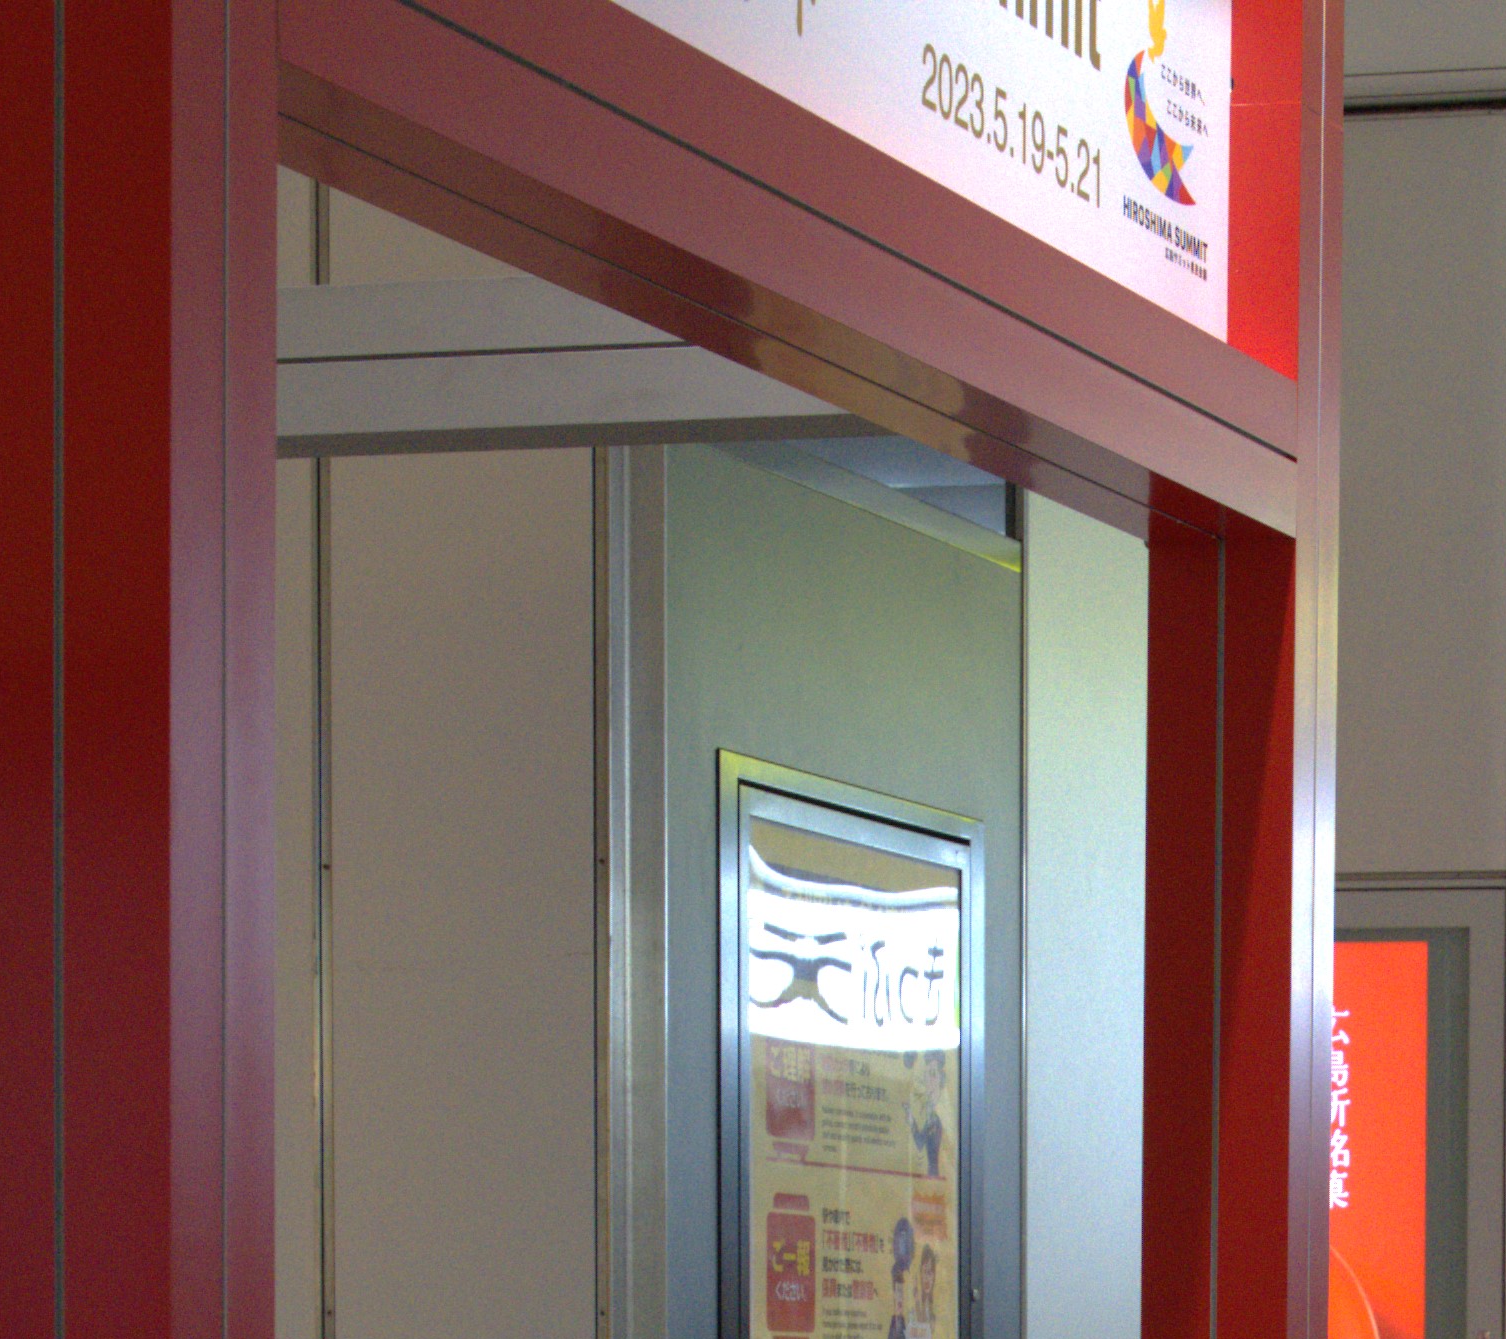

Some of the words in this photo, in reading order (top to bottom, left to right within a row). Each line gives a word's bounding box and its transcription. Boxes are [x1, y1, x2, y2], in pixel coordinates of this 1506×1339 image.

[921, 43, 1101, 209] 2023.5.19-5.21
[1123, 194, 1173, 244] HIROSHIMA
[1175, 225, 1208, 263] SUMMIT
